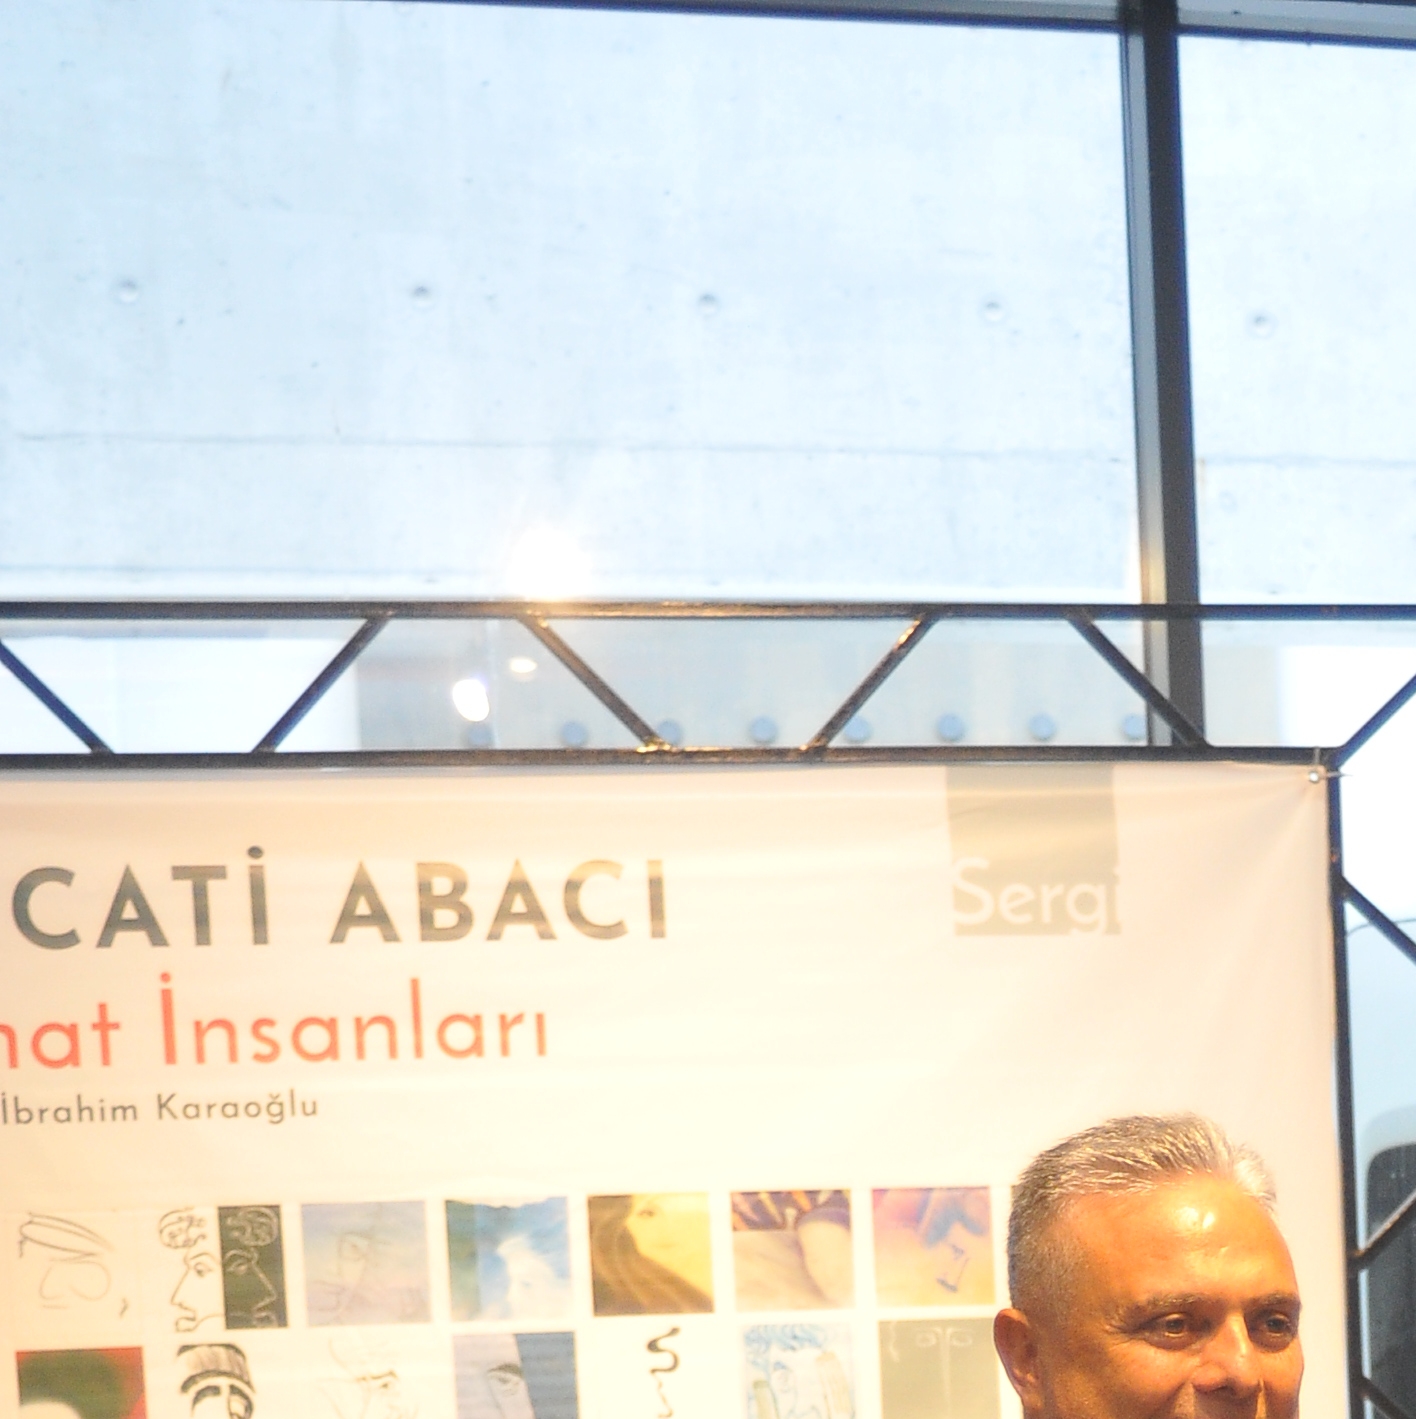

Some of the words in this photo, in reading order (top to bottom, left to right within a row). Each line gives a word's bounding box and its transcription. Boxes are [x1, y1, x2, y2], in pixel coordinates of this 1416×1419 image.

[12, 846, 271, 950] CATİ
[329, 858, 667, 944] ABACI
[159, 971, 548, 1066] İnsanları
[1, 1092, 138, 1126] İbrahim
[156, 1088, 319, 1126] Karaoğlu
